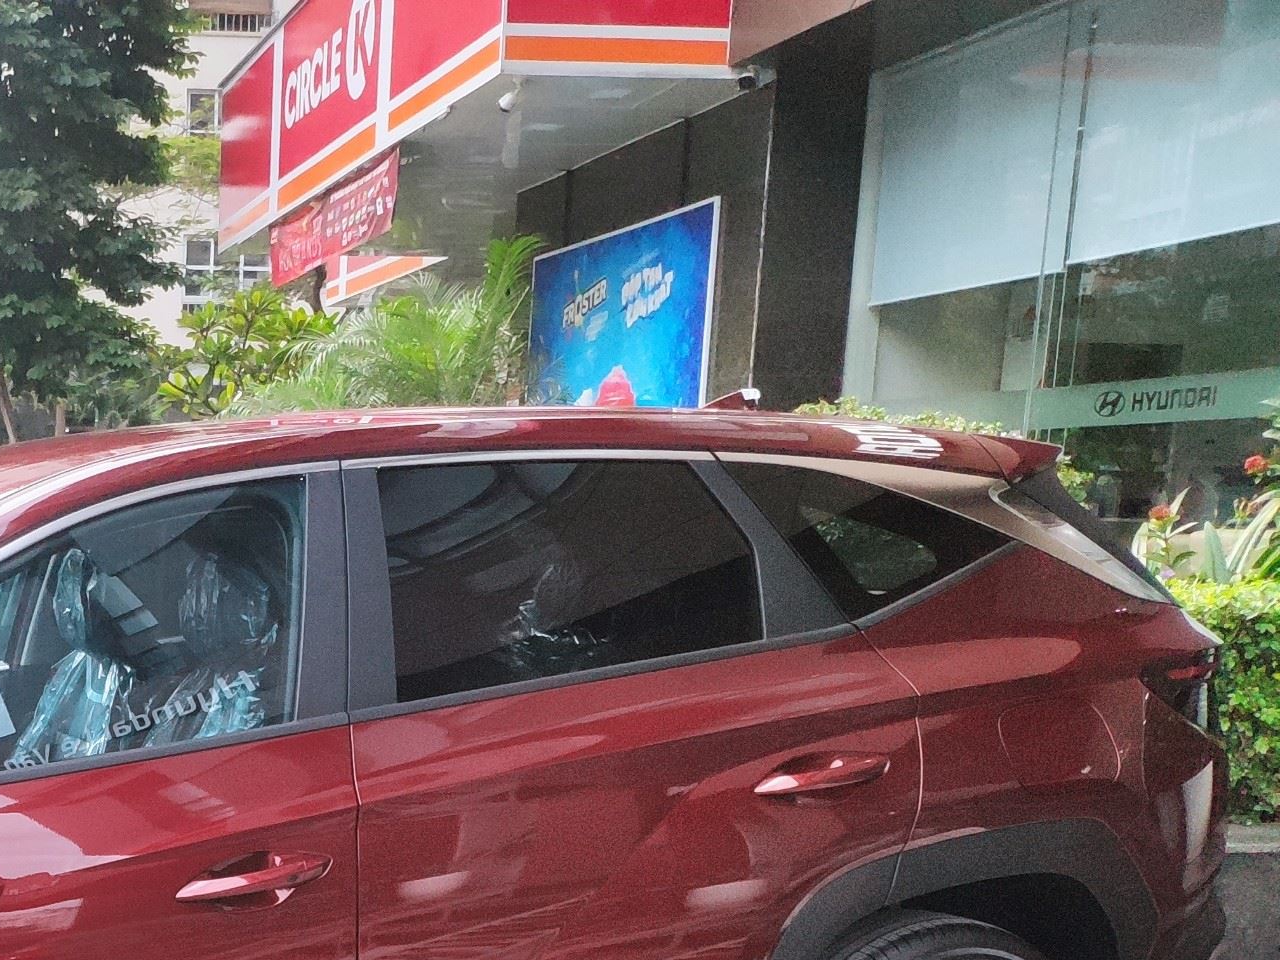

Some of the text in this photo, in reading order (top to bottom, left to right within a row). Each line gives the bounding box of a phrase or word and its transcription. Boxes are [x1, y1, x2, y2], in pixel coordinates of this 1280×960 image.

[284, 27, 343, 130] CIRCLE
[562, 276, 608, 329] FROSTER
[1131, 385, 1218, 412] HYUNDAI
